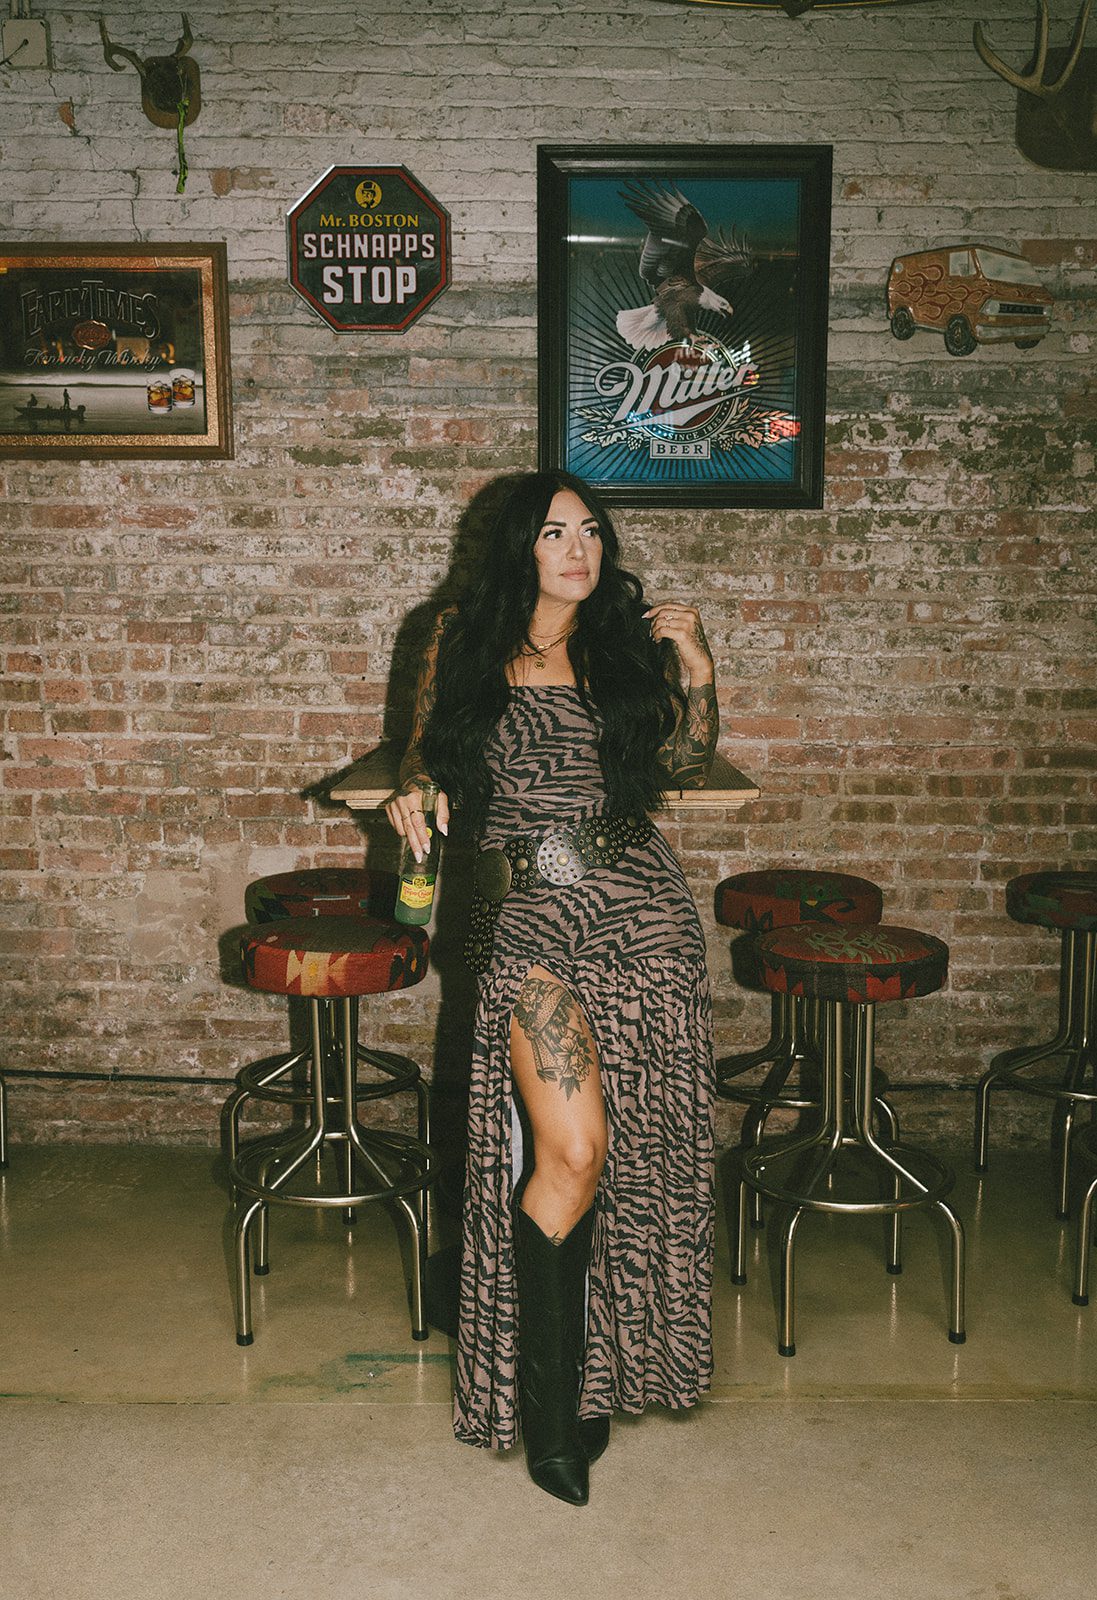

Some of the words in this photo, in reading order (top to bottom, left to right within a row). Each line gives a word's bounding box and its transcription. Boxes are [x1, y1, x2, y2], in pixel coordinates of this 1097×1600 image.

[319, 213, 346, 228] Mr.
[349, 213, 419, 228] BOSTON
[303, 233, 436, 259] SCHNAPPS
[322, 265, 418, 305] STOP
[81, 279, 161, 340] TIMES
[24, 348, 97, 372] Kentucky
[593, 360, 760, 425] Miller
[666, 431, 700, 441] SINCE
[702, 417, 723, 435] 1855
[656, 442, 704, 455] BEER
